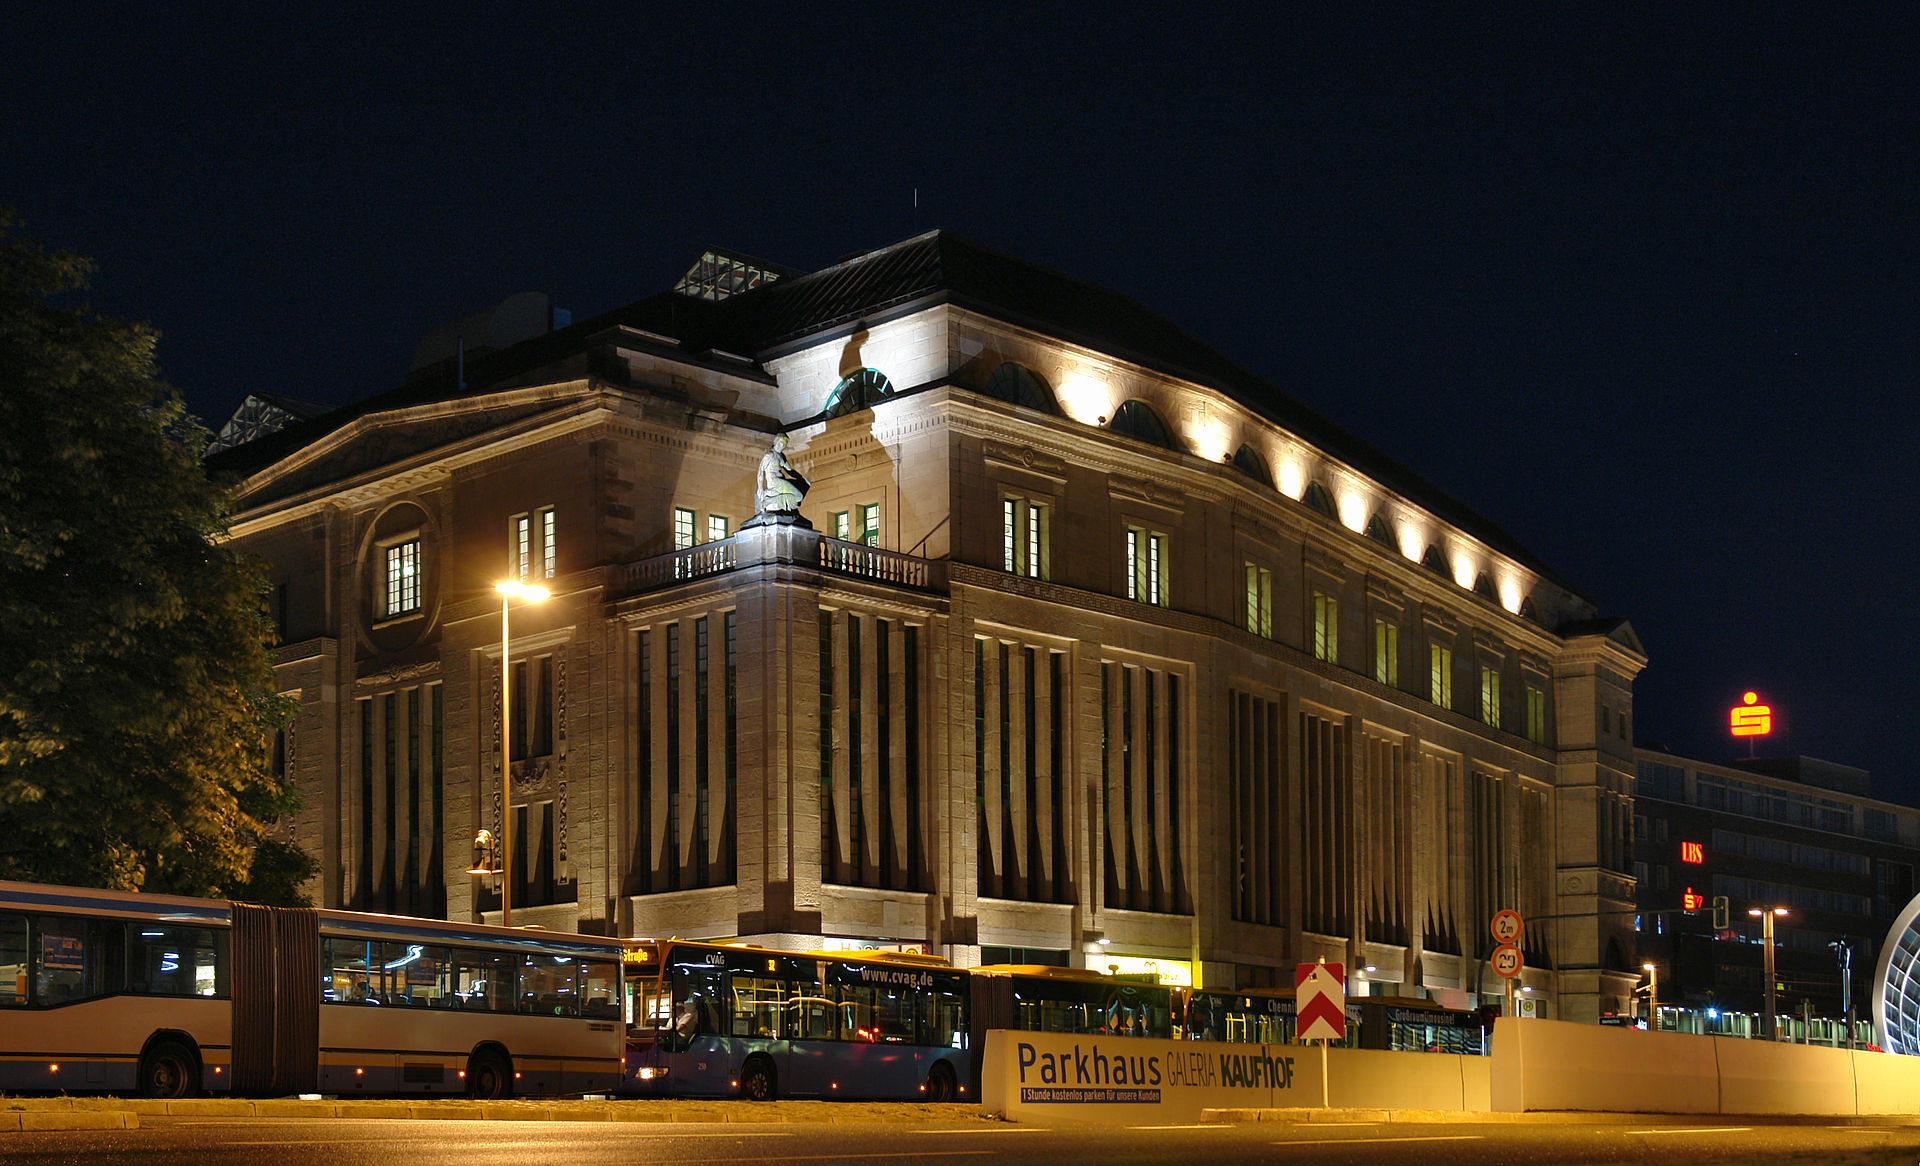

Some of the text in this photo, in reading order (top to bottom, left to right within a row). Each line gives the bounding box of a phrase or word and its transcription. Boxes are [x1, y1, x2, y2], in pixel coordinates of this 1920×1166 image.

[1681, 841, 1703, 864] LBS
[623, 948, 648, 963] Straße
[705, 954, 725, 965] CVAG
[861, 969, 934, 988] www.cvag.de
[1018, 1043, 1161, 1085] Parkhaus
[1166, 1051, 1217, 1087] GALERIA
[1027, 1089, 1051, 1101] Stunde
[1052, 1090, 1083, 1101] kostenlos
[1083, 1091, 1106, 1103] parken
[1106, 1090, 1116, 1101] für
[1117, 1092, 1137, 1101] unsere
[1138, 1091, 1160, 1101] Kunden
